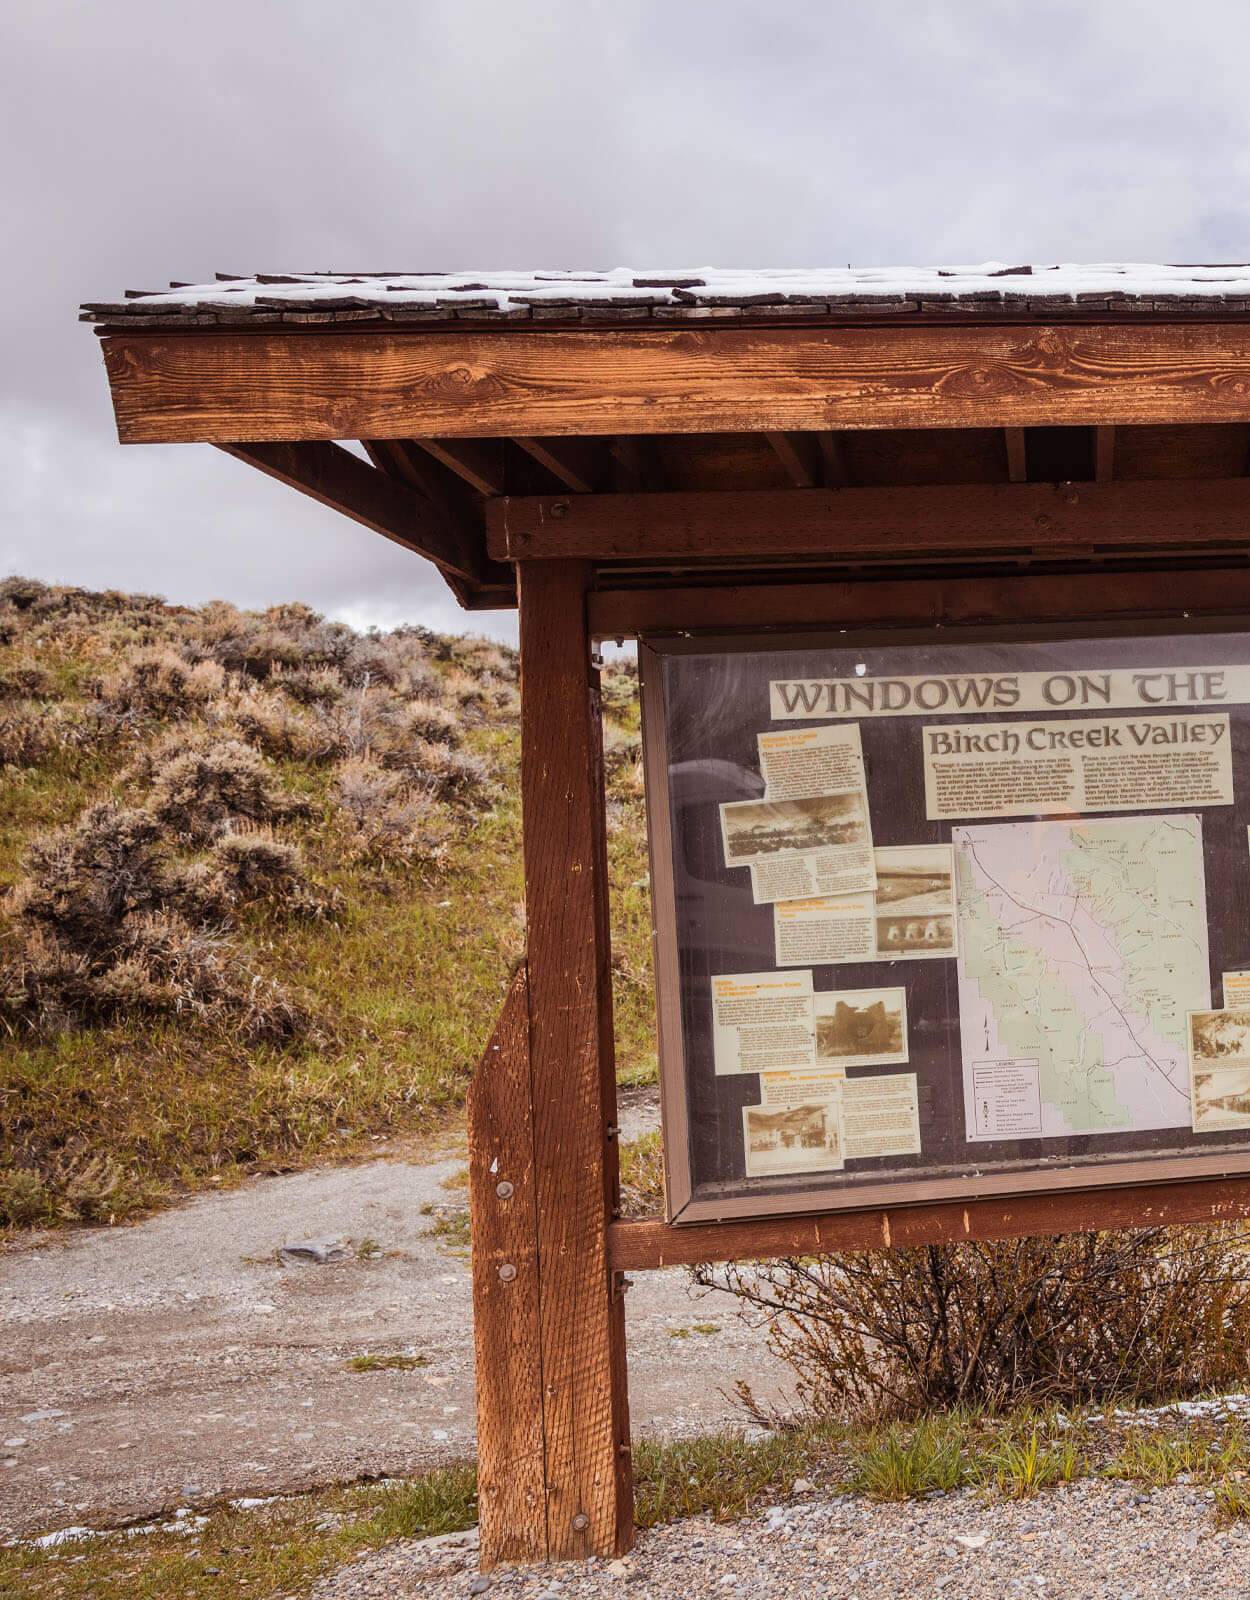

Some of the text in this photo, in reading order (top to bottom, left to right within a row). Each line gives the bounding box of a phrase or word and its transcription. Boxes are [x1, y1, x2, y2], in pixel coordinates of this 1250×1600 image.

[775, 676, 1021, 713] WINDOWS
[1041, 674, 1112, 705] ON
[1132, 671, 1227, 703] THE
[928, 720, 1226, 755] Birch Creek Valley
